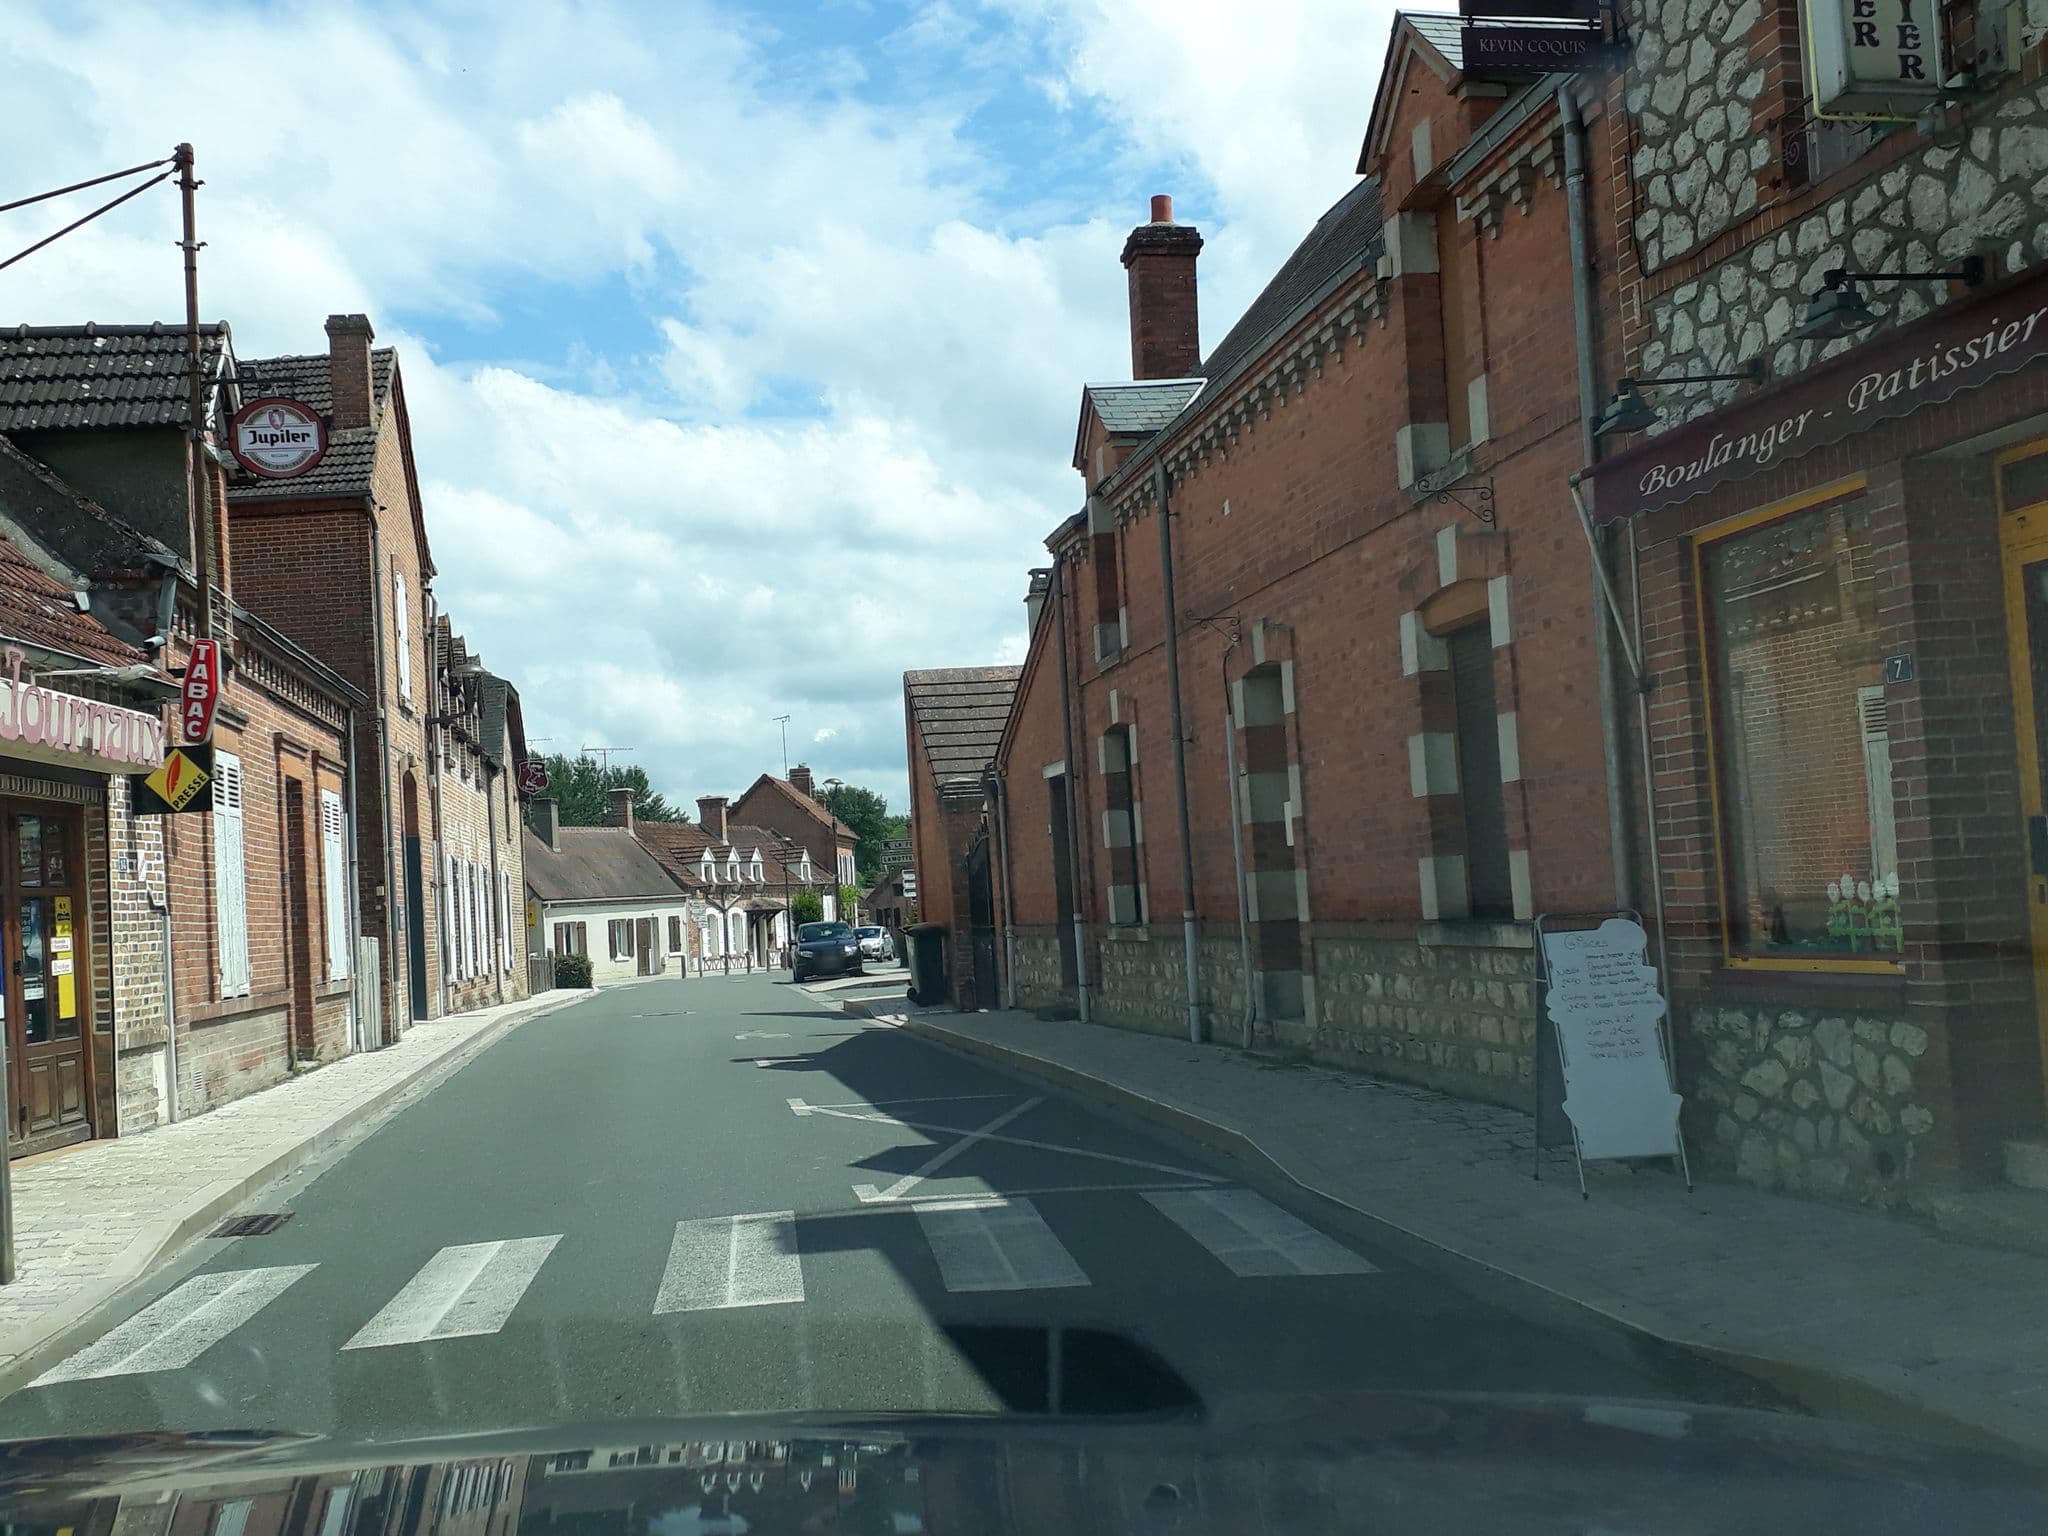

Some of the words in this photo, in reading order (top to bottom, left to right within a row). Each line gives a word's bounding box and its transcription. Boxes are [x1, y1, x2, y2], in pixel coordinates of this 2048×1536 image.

[1480, 39, 1523, 53] KEVIN
[1527, 39, 1586, 56] COQUIS
[1638, 408, 1813, 496] Boulanger
[1847, 307, 2048, 415] Patissier
[248, 429, 311, 447] Jupiler
[1893, 659, 1903, 679] 7
[0, 646, 167, 769] Journaux
[187, 644, 209, 738] TABAC
[171, 773, 208, 810] PRESSE
